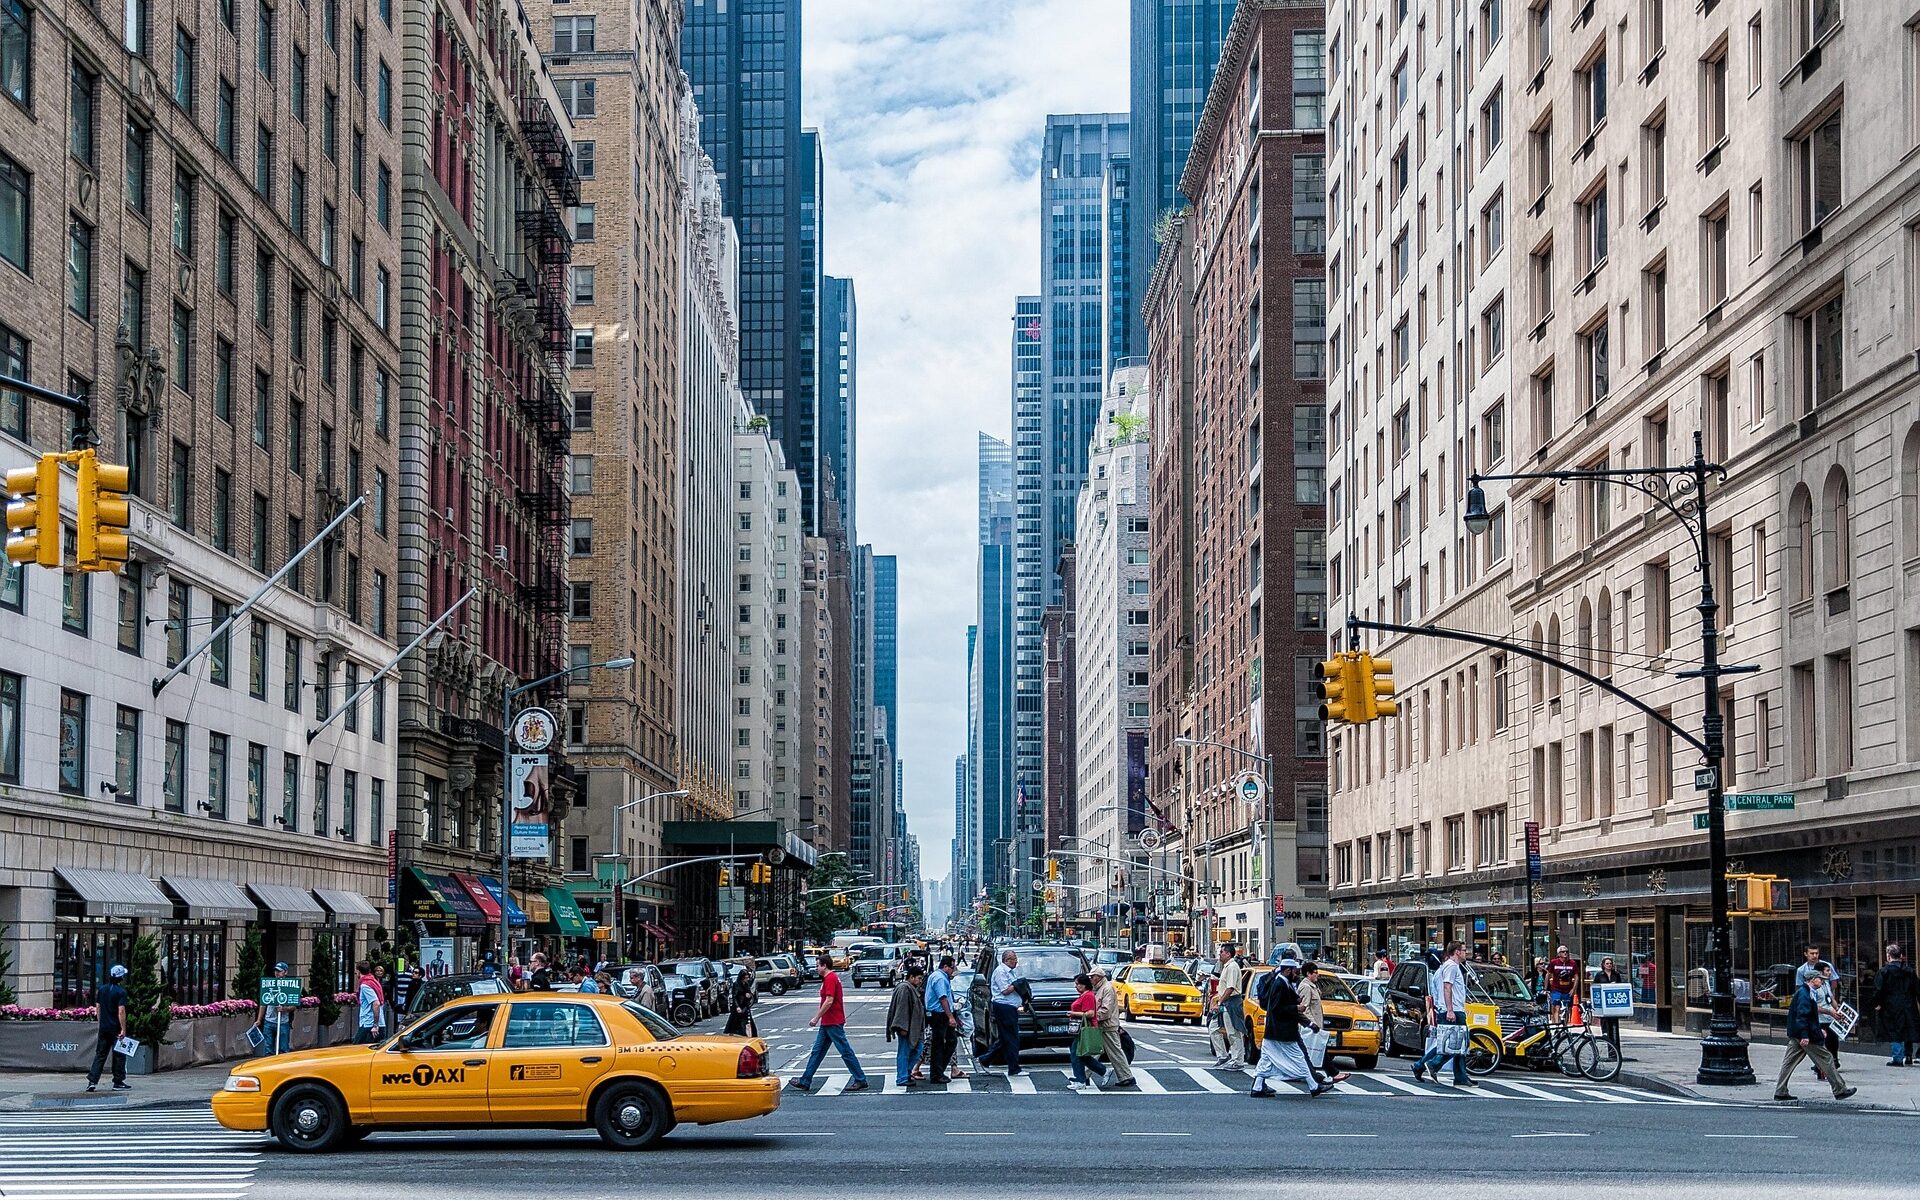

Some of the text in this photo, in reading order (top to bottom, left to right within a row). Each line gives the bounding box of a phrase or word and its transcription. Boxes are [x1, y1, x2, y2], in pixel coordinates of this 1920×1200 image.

[521, 757, 539, 765] NYC
[1737, 796, 1793, 805] CENTRAL PARK
[261, 980, 299, 988] BIKE RENTAL
[41, 1042, 79, 1051] MARKET
[382, 1065, 464, 1085] NYC TAXI
